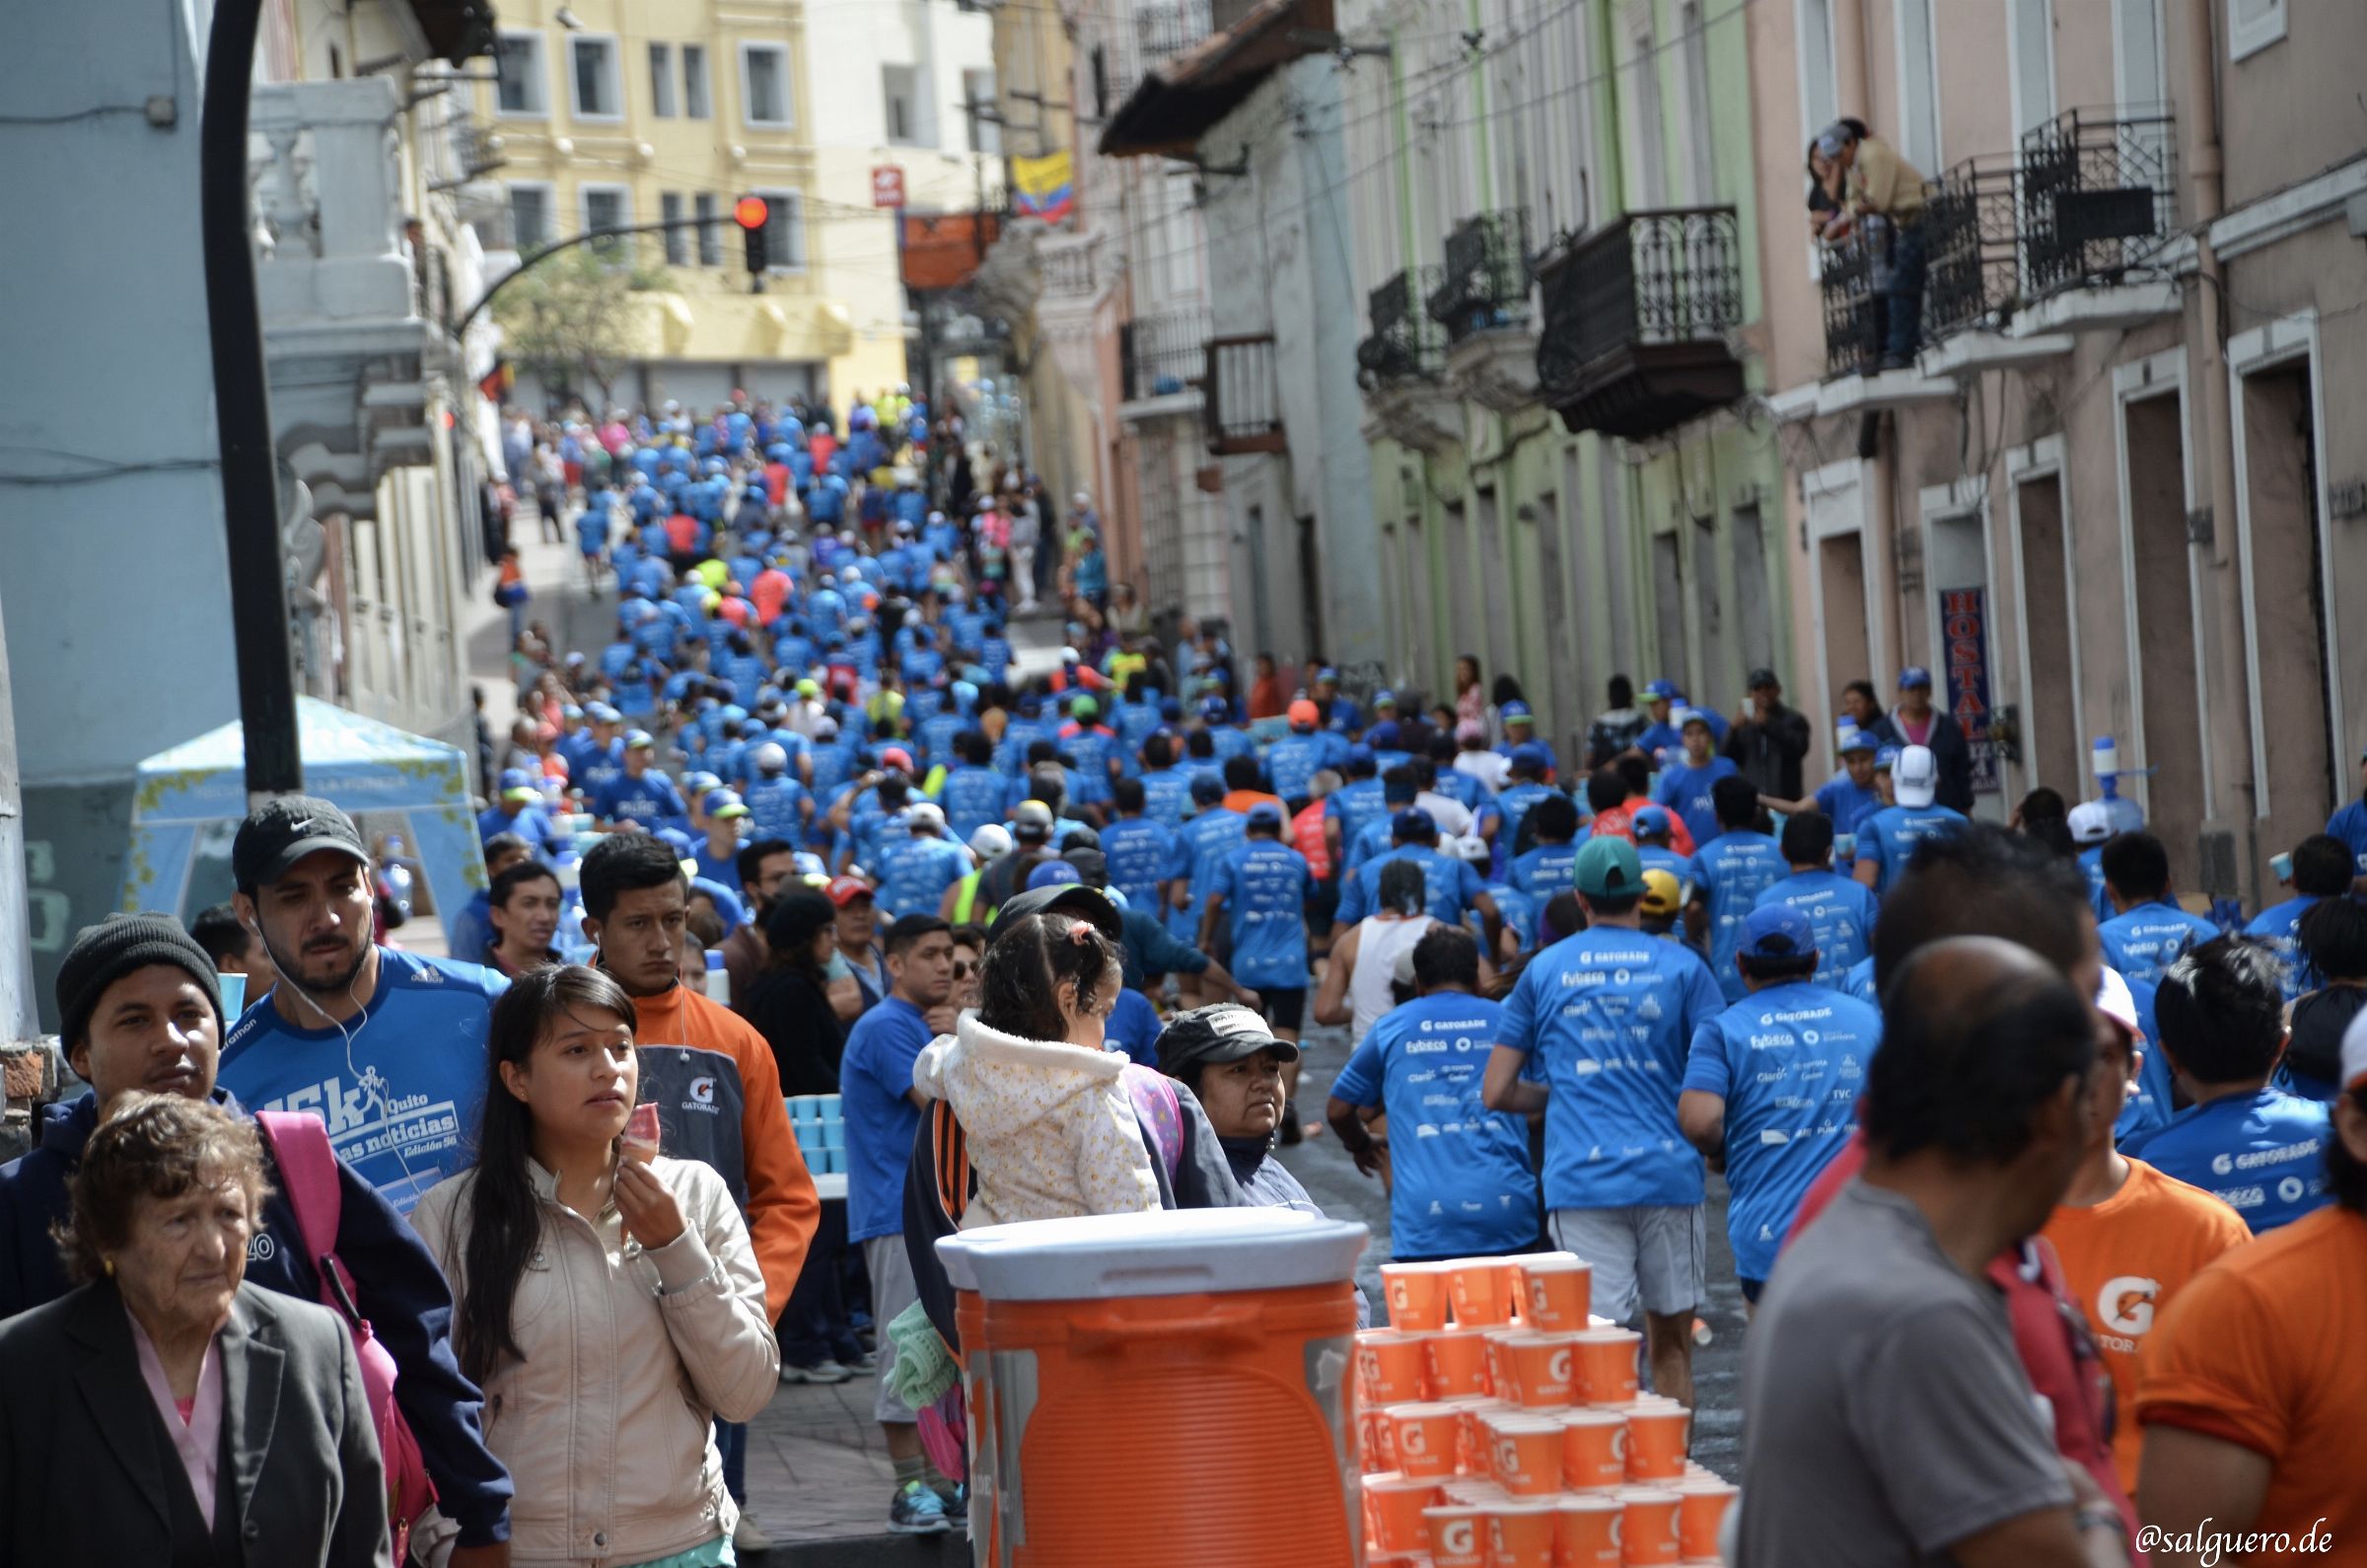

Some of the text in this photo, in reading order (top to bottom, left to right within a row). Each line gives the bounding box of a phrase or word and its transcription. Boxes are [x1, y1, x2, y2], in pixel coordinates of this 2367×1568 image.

[1946, 592, 1987, 742] HOSTAL
[1595, 951, 1649, 962] GATORADE
[1434, 1020, 1487, 1031] GATORADE
[1775, 1007, 1831, 1022] GATORADE
[388, 1093, 429, 1115] Quito
[368, 1113, 457, 1154] noticias
[404, 1141, 443, 1159] Edición
[2235, 1138, 2320, 1170] GATORADE
[1443, 1521, 1474, 1555] G
